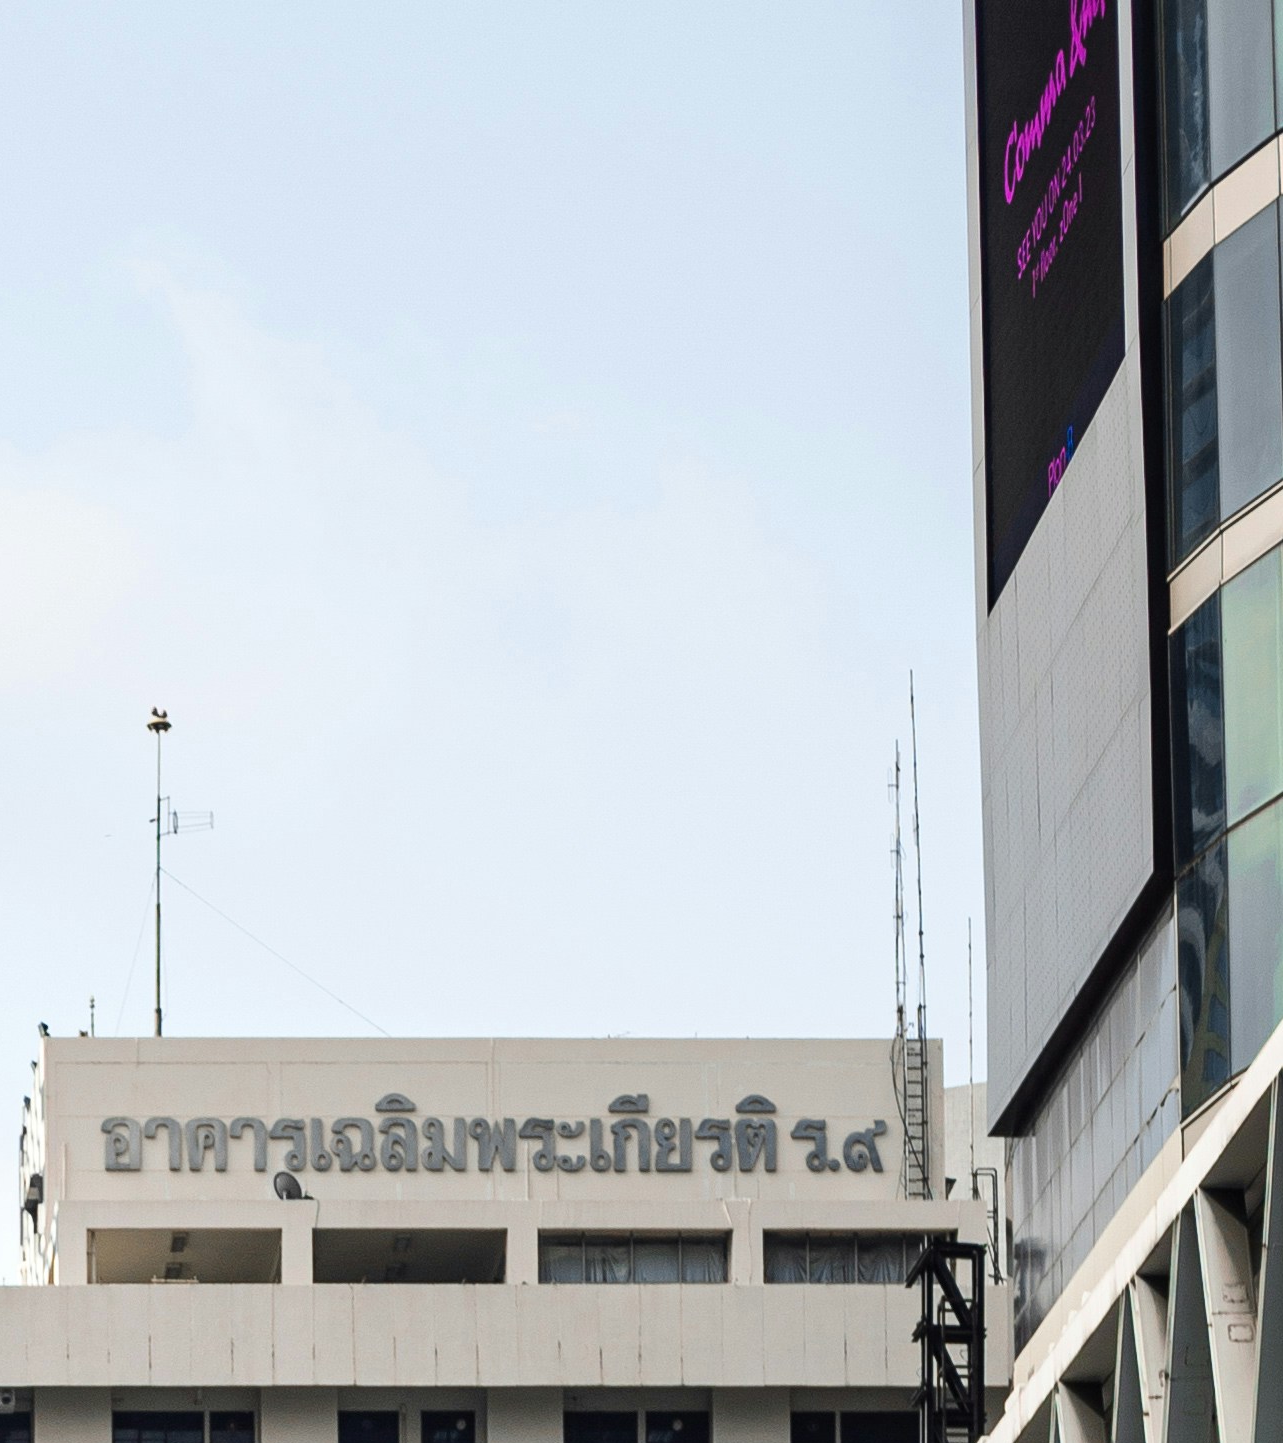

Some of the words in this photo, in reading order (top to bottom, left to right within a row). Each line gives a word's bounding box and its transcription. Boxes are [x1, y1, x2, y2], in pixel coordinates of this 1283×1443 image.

[1003, 48, 1067, 205] Comma
[1017, 228, 1031, 280] SEE
[1032, 193, 1048, 248] YOU
[1048, 167, 1060, 215] ON
[1061, 95, 1096, 189] 24.03.23
[100, 1093, 777, 1173] อาคารเฉลิมพระเกียรติ
